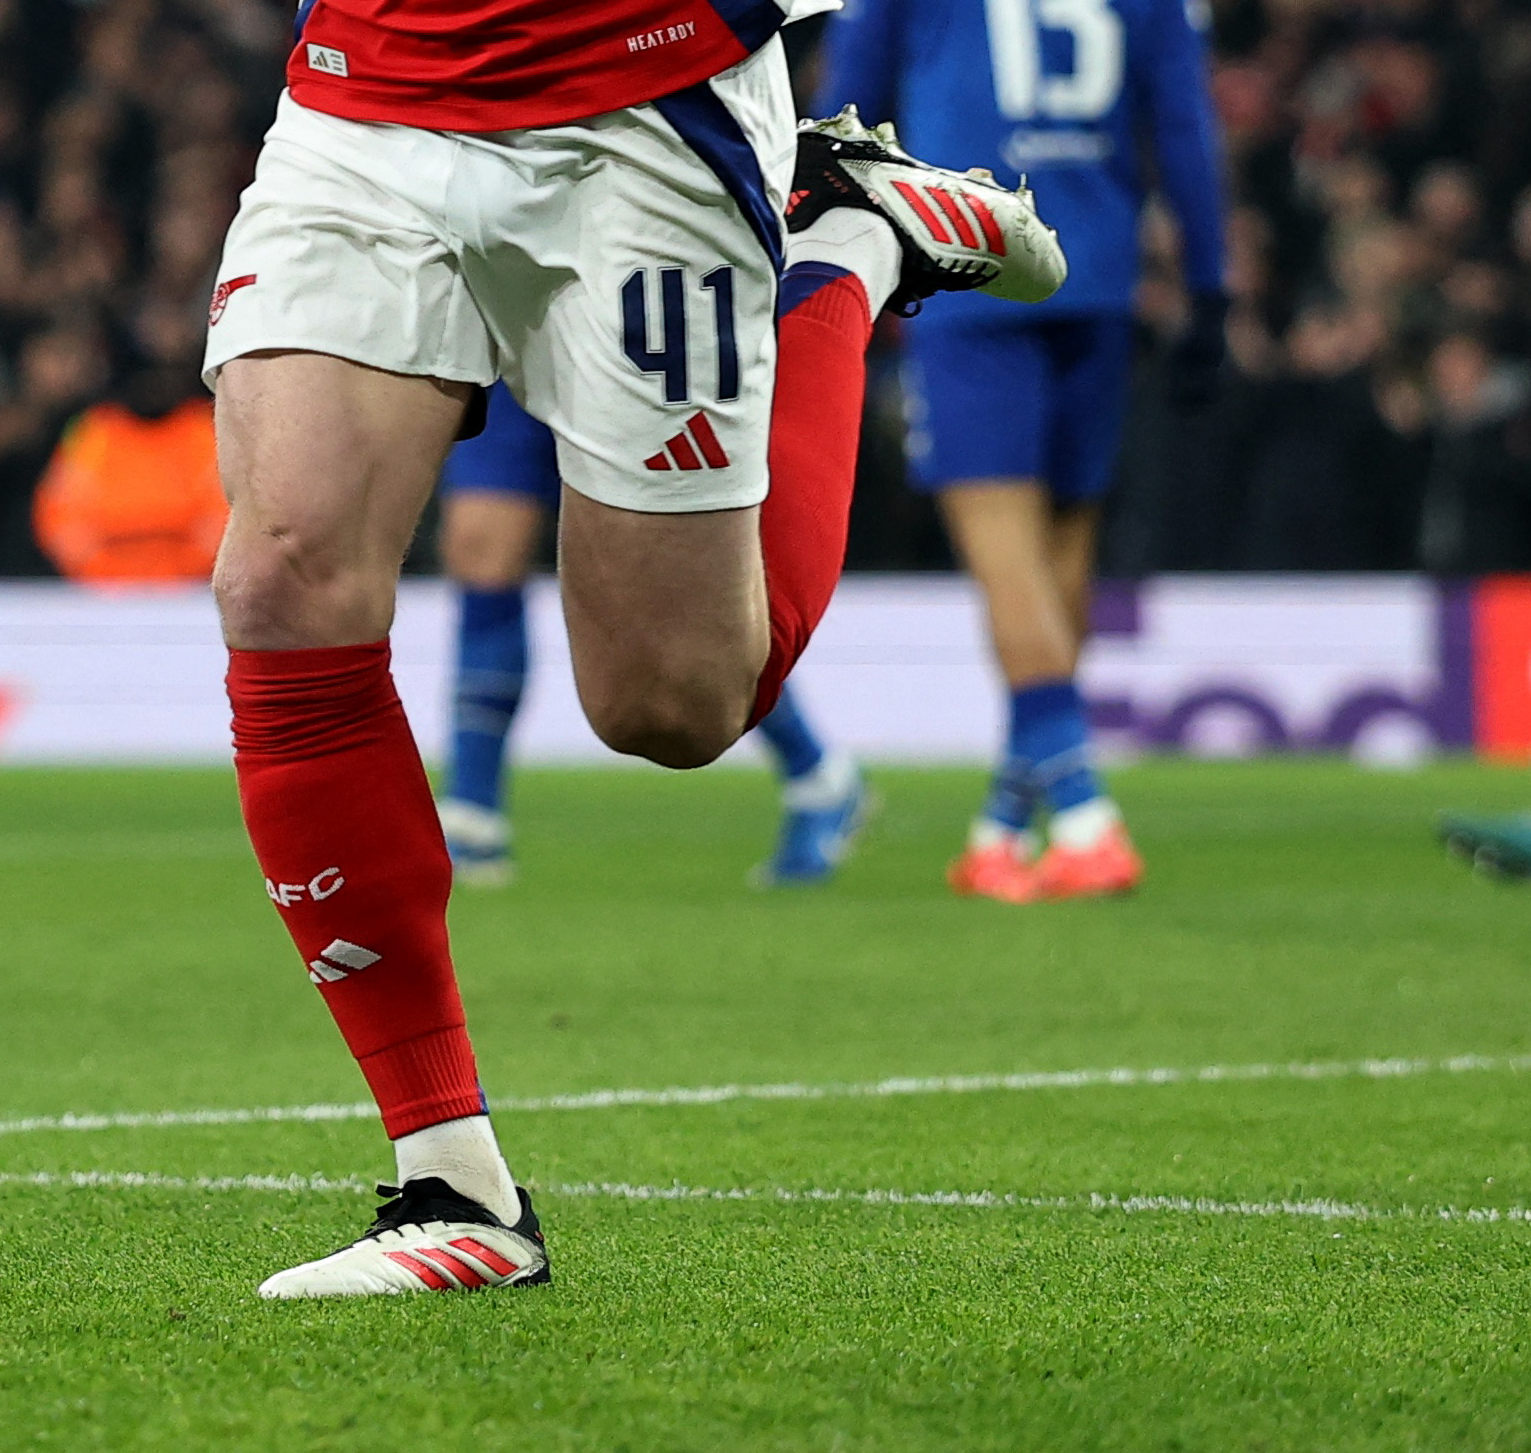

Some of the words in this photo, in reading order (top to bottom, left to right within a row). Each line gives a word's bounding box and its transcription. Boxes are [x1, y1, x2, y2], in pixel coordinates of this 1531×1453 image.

[626, 20, 696, 53] HEAT.RDY
[618, 263, 742, 406] 41
[265, 867, 345, 908] AFC
